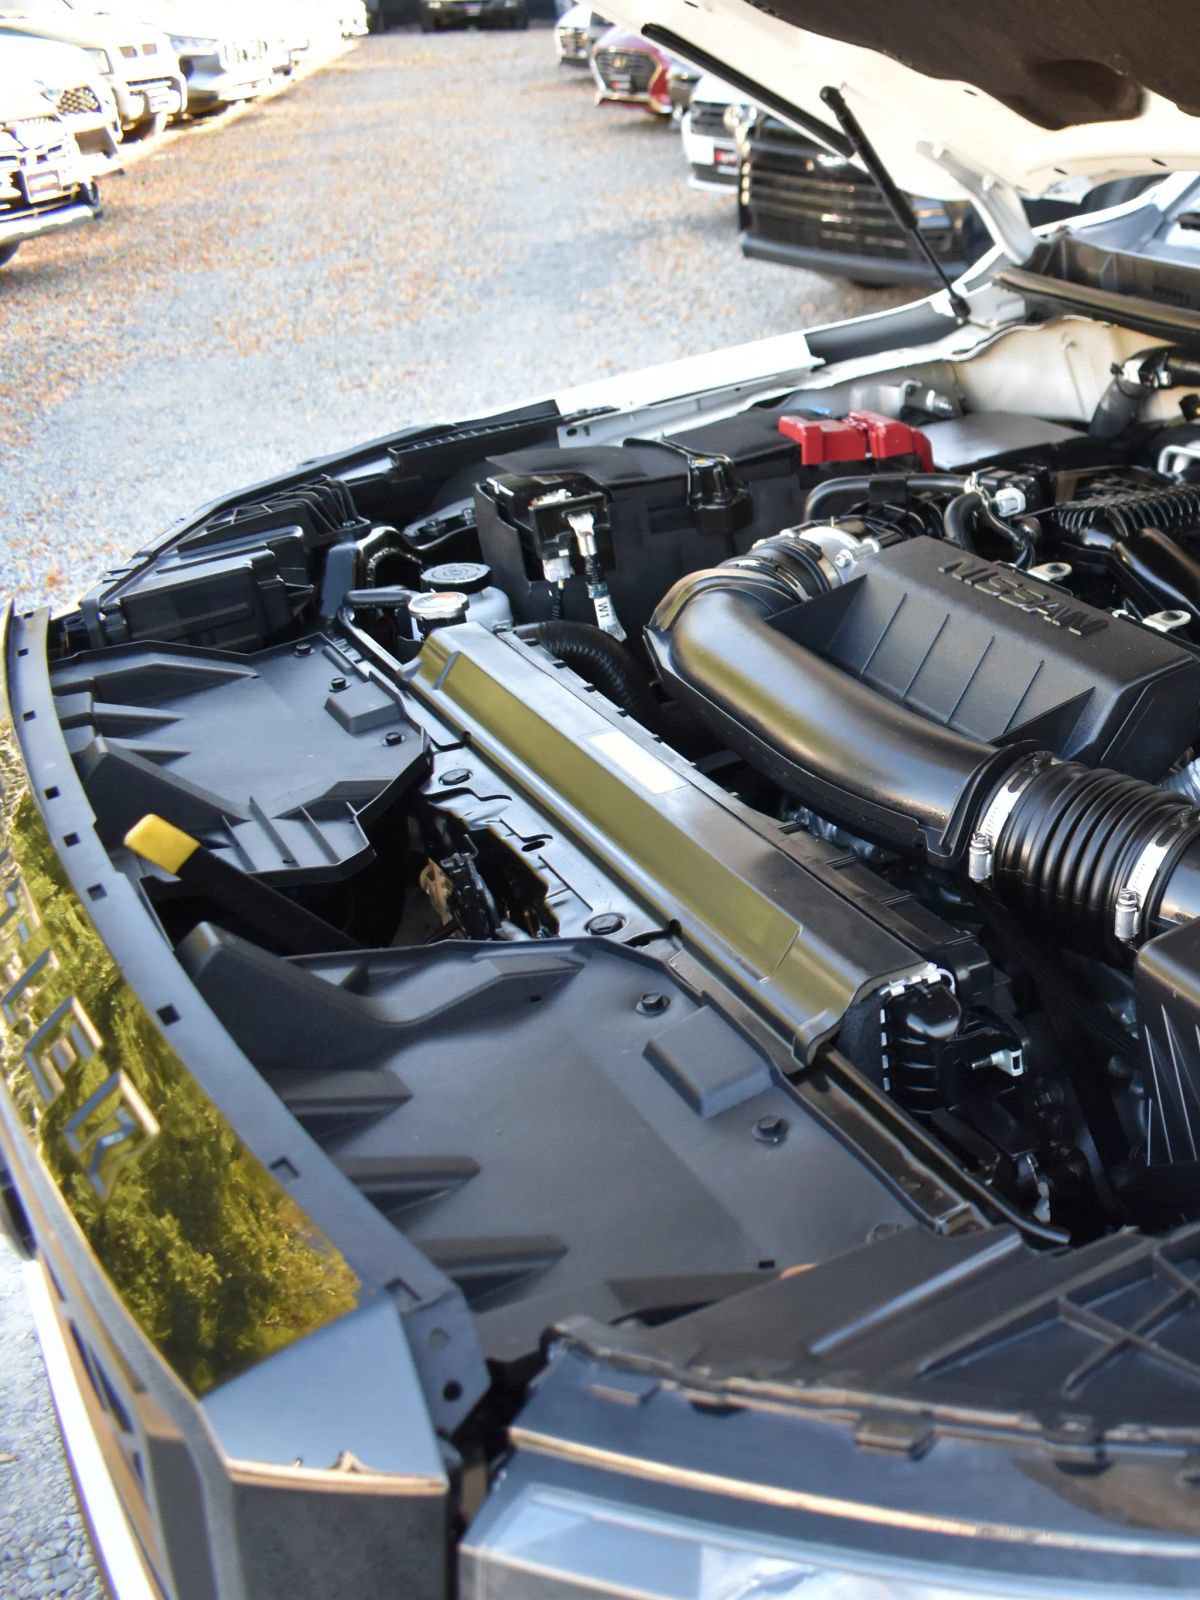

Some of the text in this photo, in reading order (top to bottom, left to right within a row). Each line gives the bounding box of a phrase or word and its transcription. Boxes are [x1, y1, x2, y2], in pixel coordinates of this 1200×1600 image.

[598, 601, 611, 618] W1
[938, 560, 1109, 637] NISSAN
[0, 848, 160, 1197] TIER
